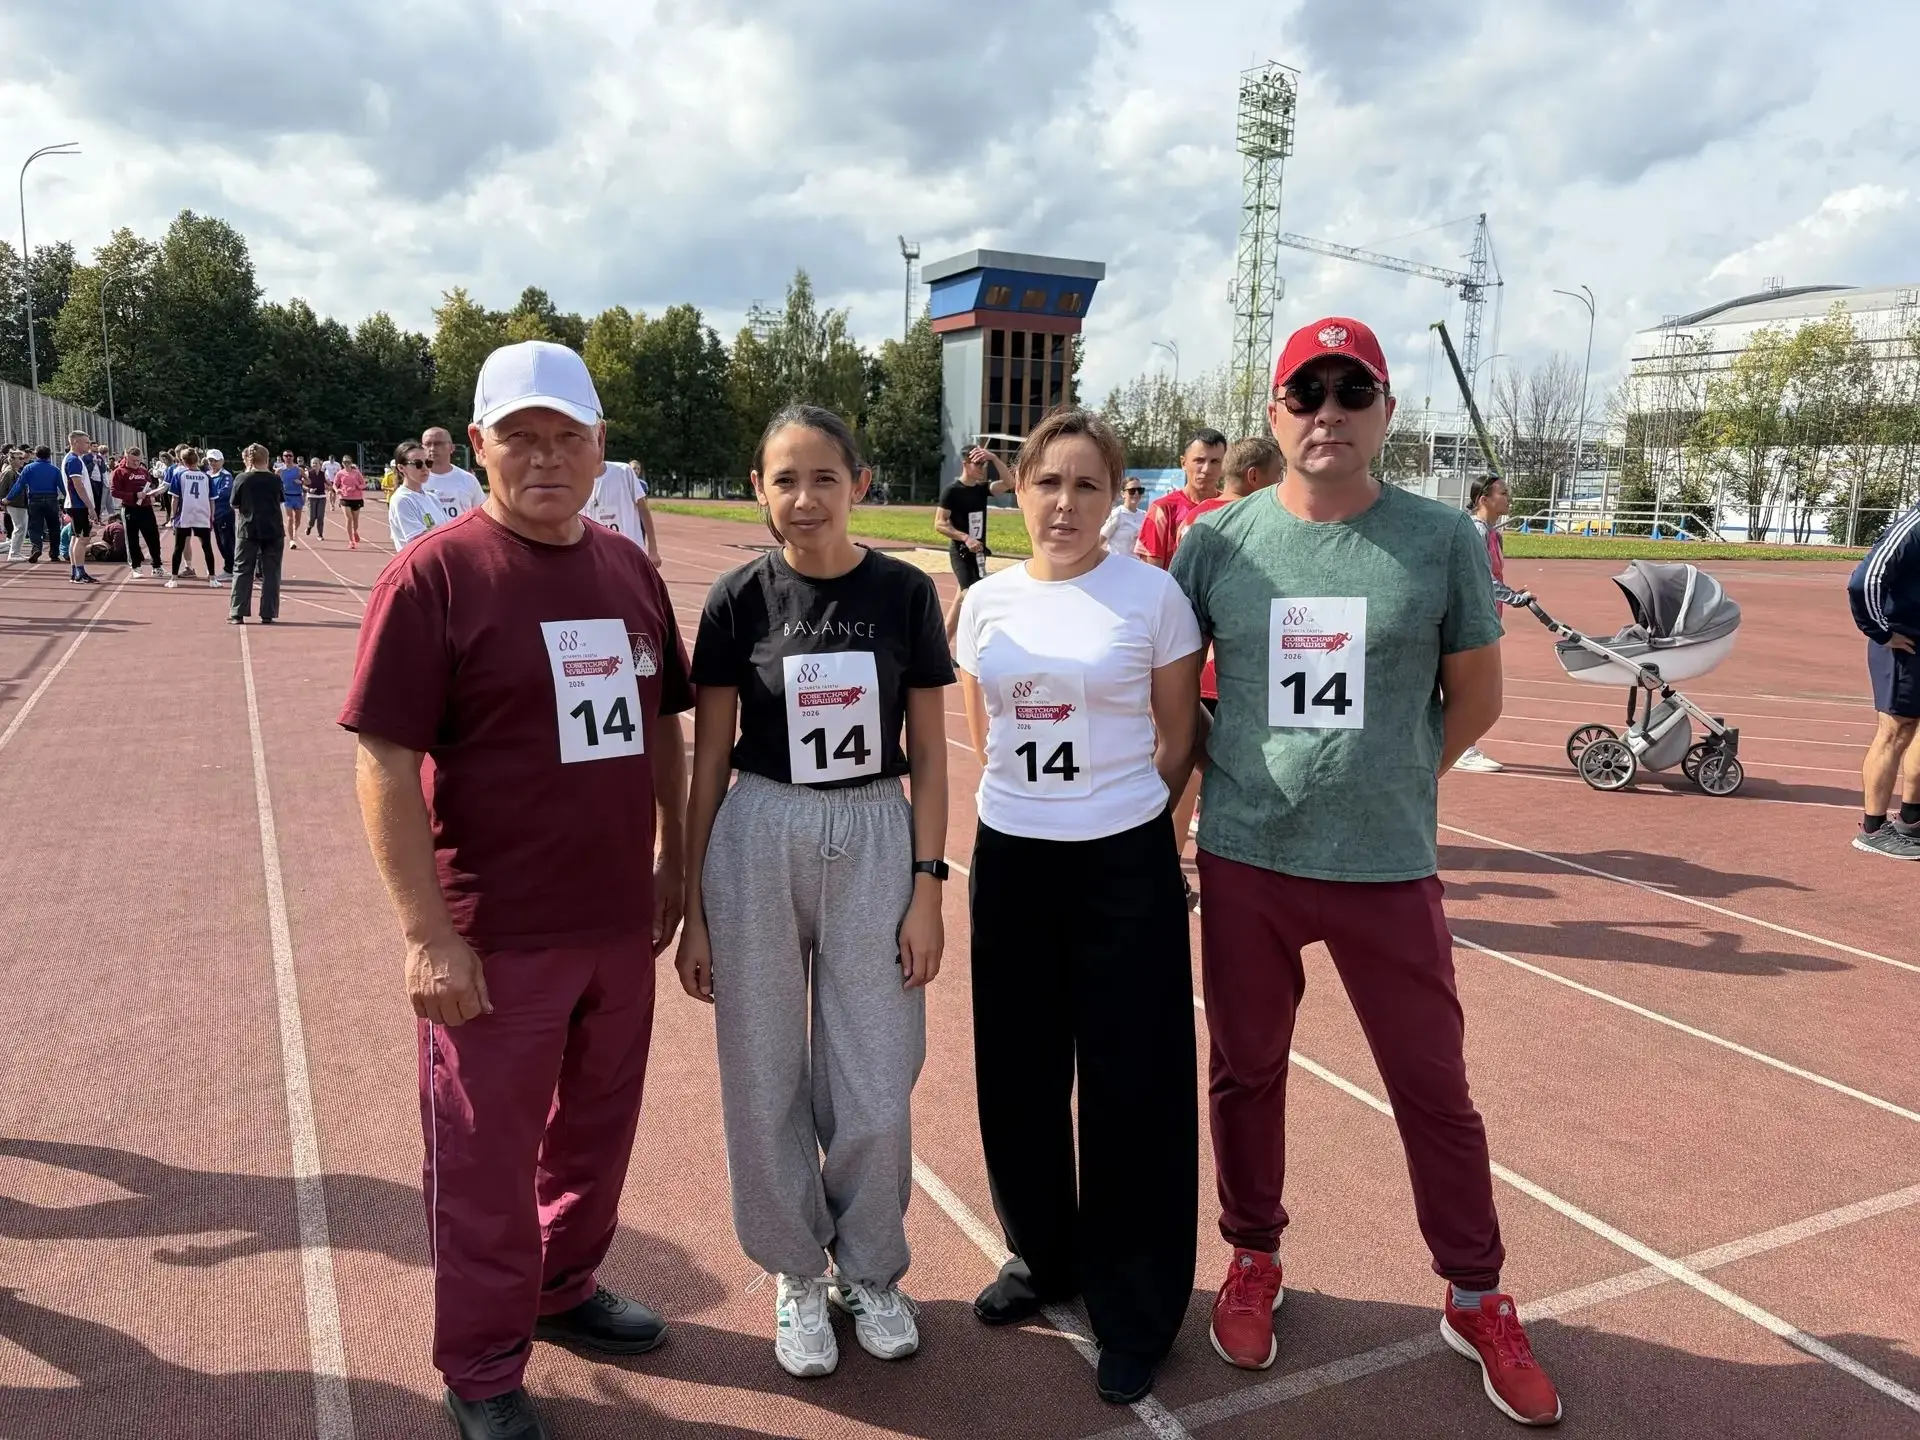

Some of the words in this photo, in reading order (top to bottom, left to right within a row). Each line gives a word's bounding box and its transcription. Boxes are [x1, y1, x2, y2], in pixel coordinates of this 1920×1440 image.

[190, 482, 200, 499] 4
[973, 526, 980, 537] 7
[783, 620, 876, 639] BALANCE
[565, 660, 609, 669] СОВЕТСКАЯ
[565, 667, 604, 675] ЧУВАШИЯ
[568, 680, 585, 688] 2026
[801, 691, 849, 700] СОВЕТСКАЯ
[1280, 671, 1353, 716] 14
[570, 696, 636, 747] 14
[800, 724, 872, 770] 14
[1014, 741, 1080, 782] 14
